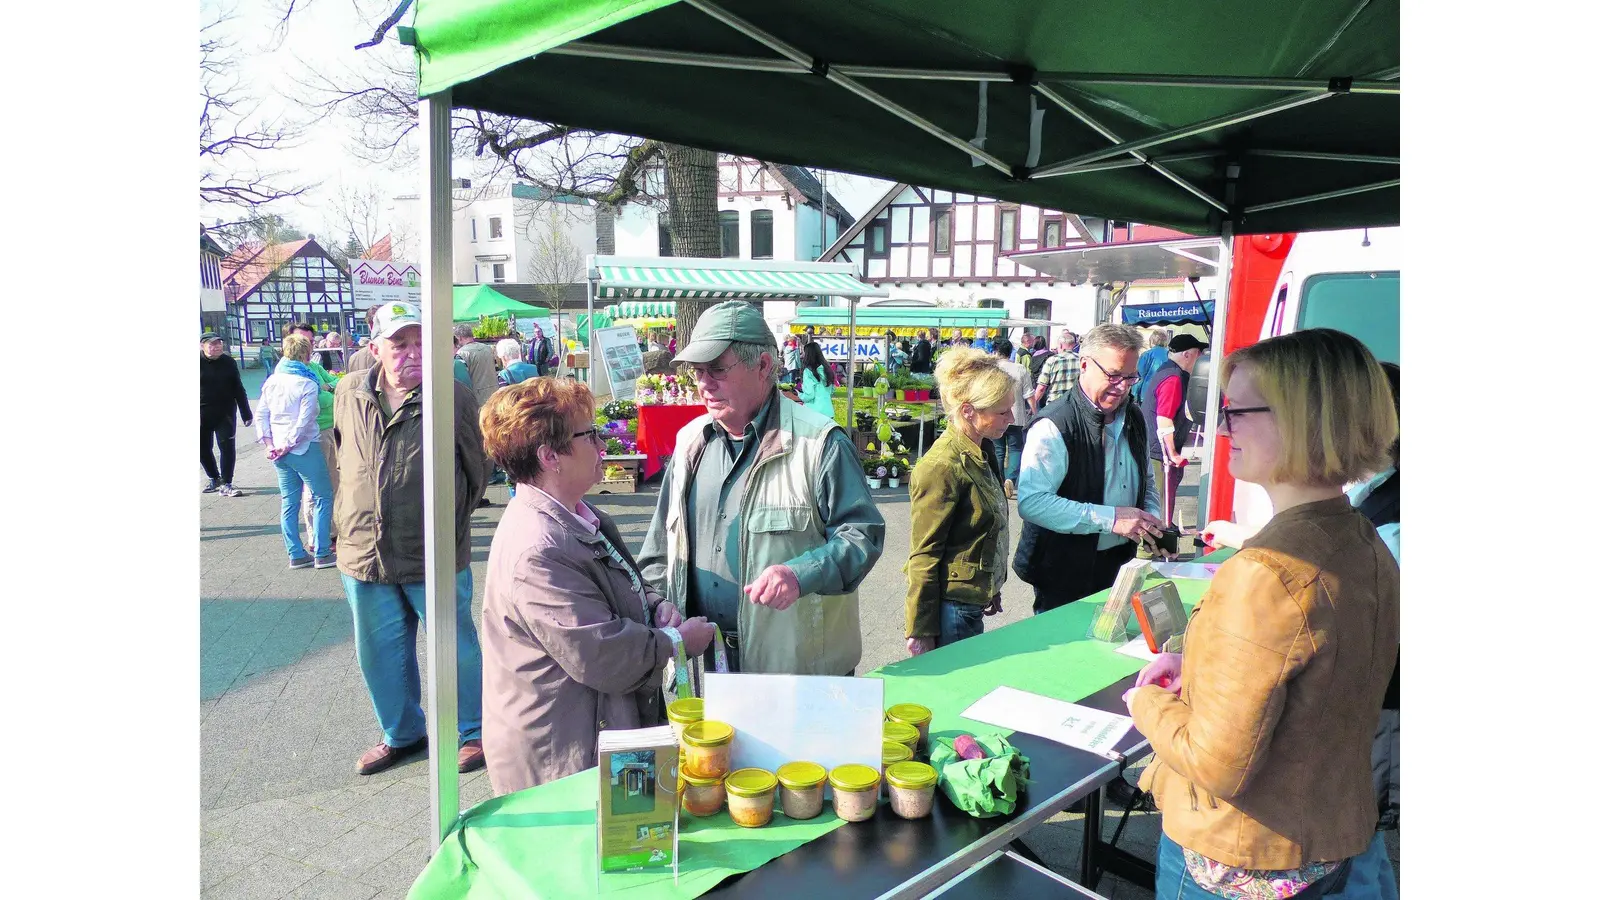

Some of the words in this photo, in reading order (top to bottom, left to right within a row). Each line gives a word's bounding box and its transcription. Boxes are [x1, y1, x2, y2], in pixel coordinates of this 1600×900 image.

[359, 270, 385, 285] Blumen
[387, 272, 403, 286] Benz
[1138, 306, 1199, 318] Räucherfisch
[820, 343, 880, 356] HELNA
